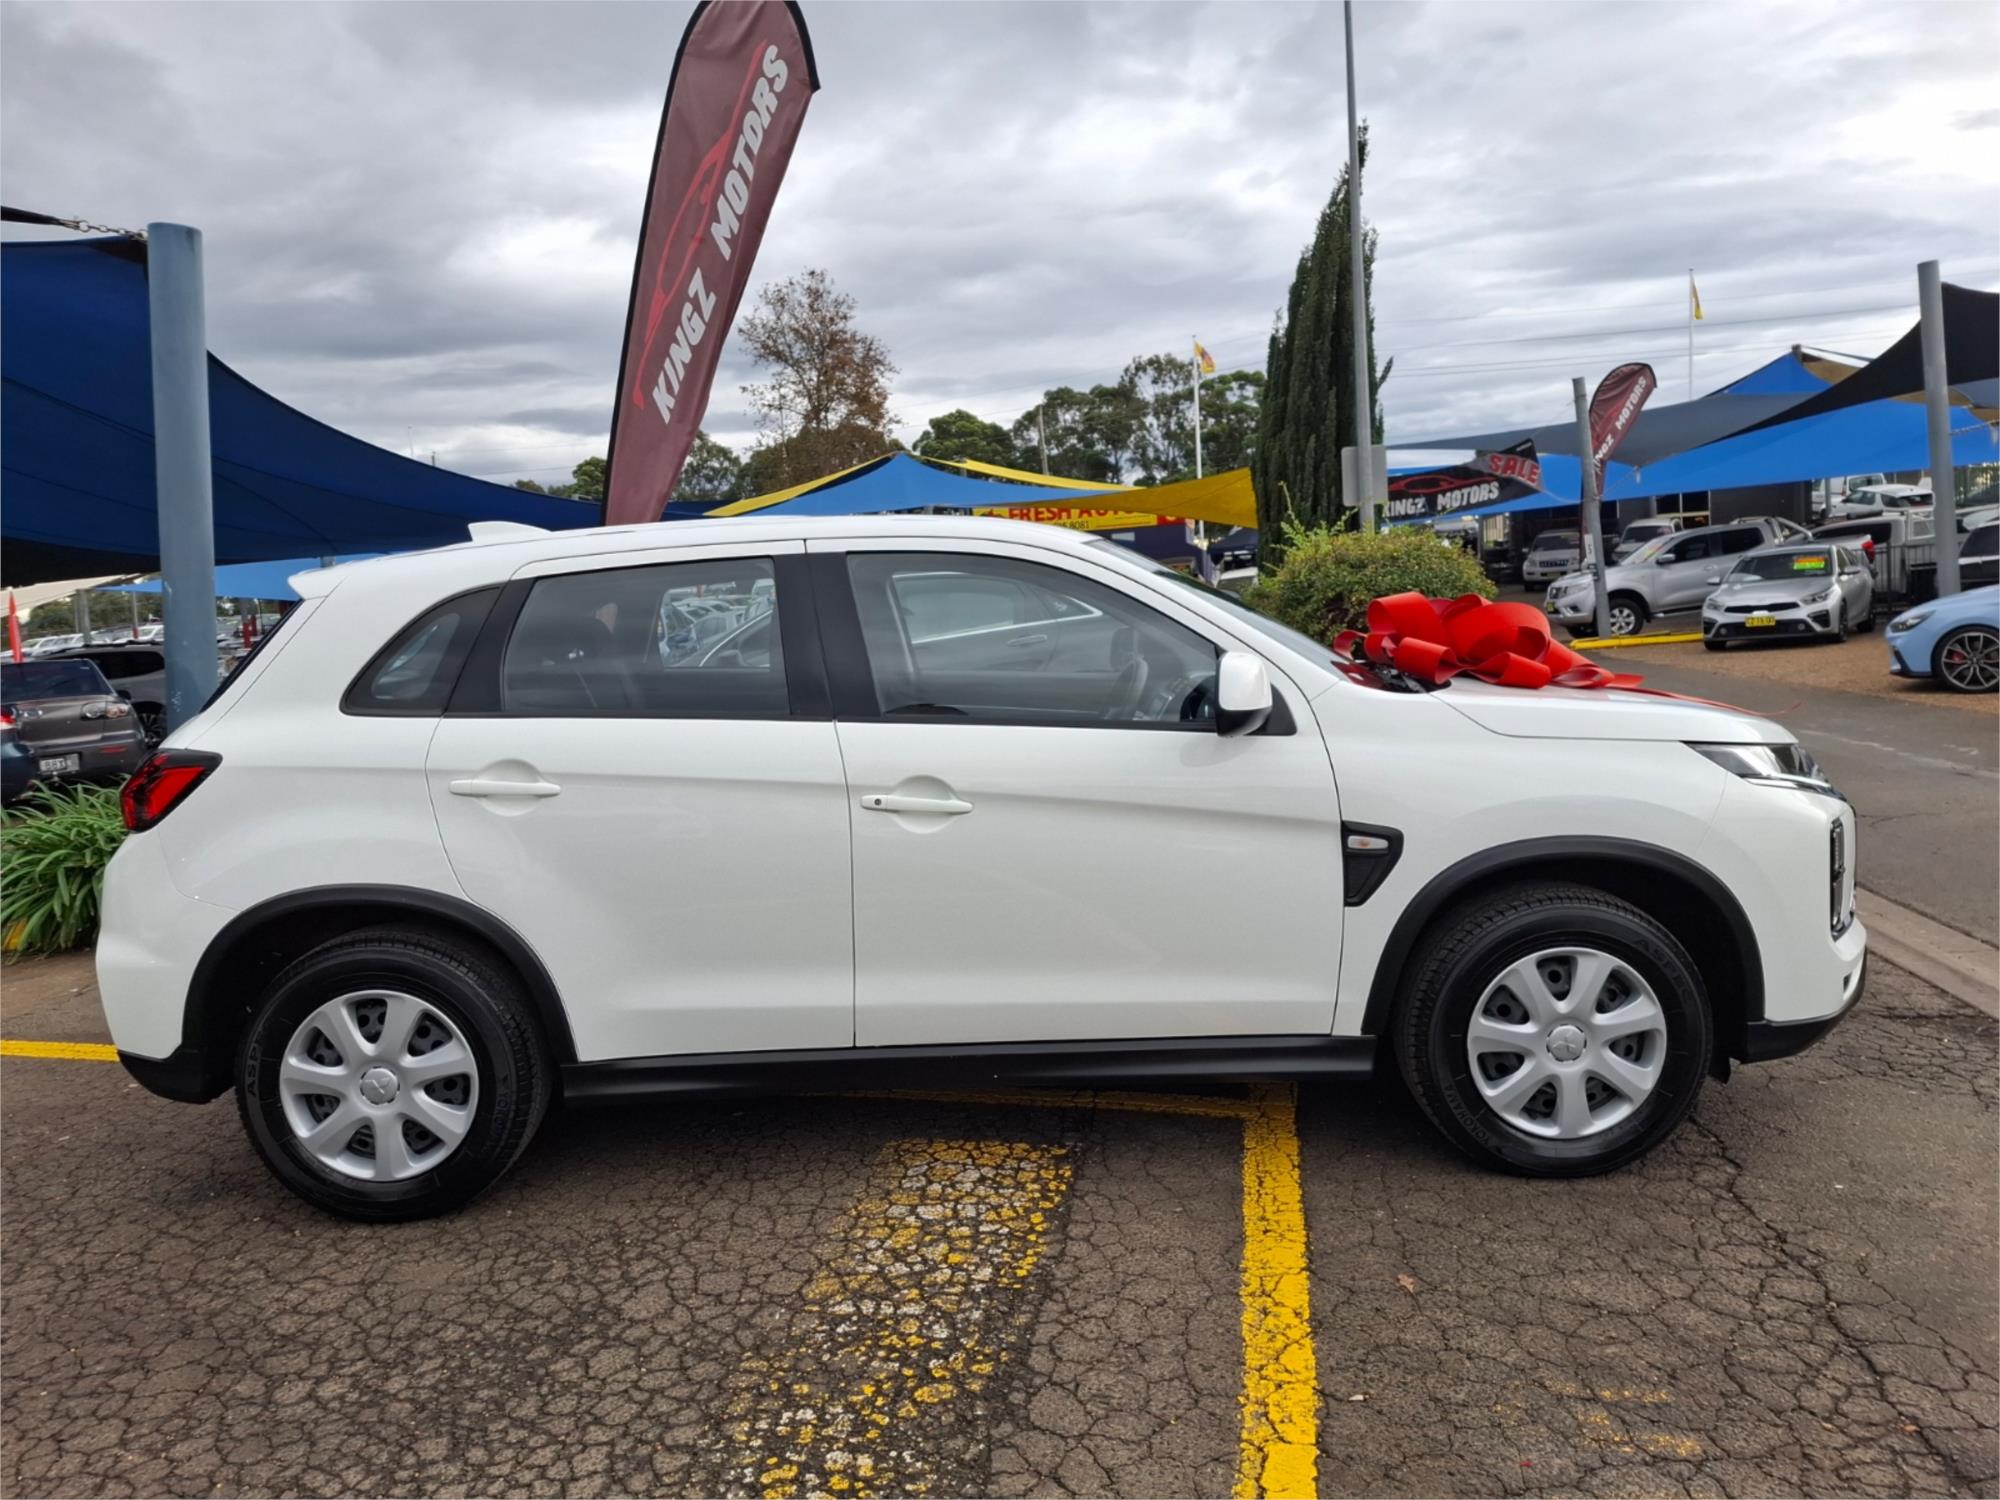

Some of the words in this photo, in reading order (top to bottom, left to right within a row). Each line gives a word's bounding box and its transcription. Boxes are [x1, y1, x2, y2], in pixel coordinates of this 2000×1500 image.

[651, 267, 717, 425] KINGZ
[710, 44, 789, 261] MOTORS
[1615, 376, 1647, 430] MOTORS
[1488, 454, 1538, 485] SALE
[1437, 481, 1499, 511] MOTORS
